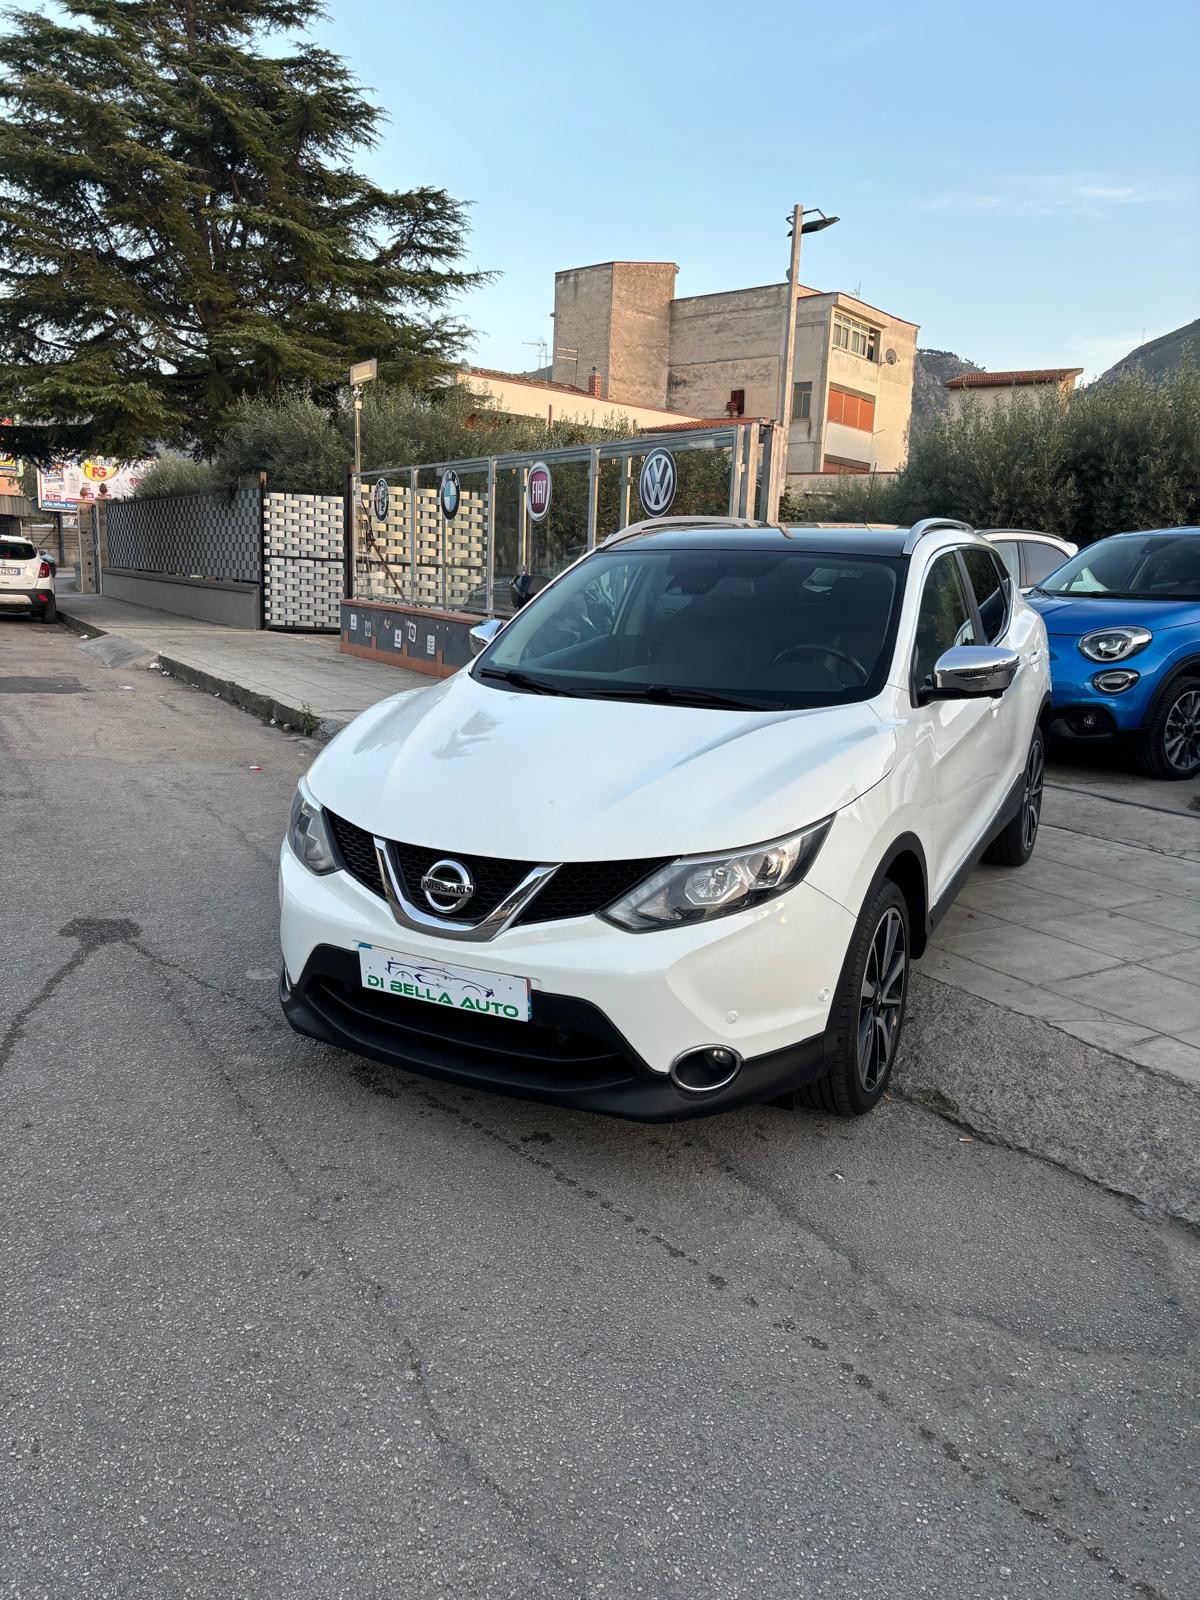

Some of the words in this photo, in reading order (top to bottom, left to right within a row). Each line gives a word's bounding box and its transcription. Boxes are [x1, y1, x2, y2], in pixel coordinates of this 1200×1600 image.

[532, 479, 547, 505] FIAT
[423, 879, 466, 895] NISSAN
[367, 974, 385, 989] DI
[390, 979, 453, 1006] BELLA
[460, 996, 519, 1018] AUTO
